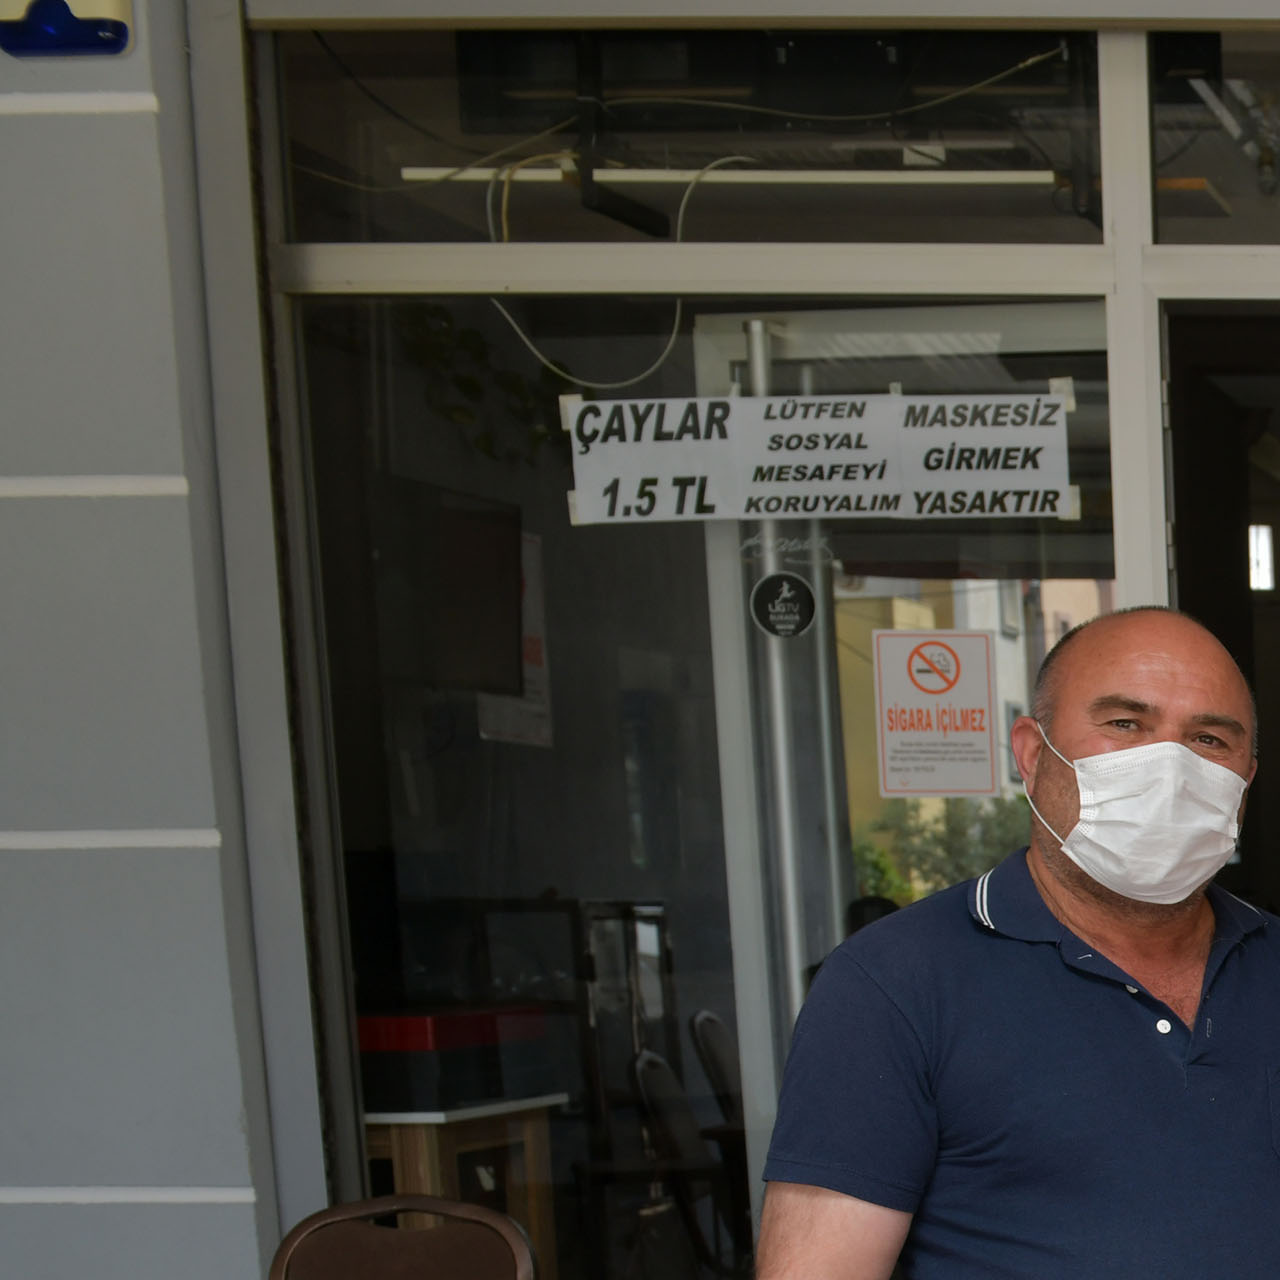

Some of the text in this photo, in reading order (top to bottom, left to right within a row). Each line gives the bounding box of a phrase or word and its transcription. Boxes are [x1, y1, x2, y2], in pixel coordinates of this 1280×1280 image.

[763, 399, 867, 420] LÜTFEN
[903, 398, 1061, 428] MASKESİZ
[575, 400, 730, 454] ÇAYLAR
[768, 433, 868, 451] SOSYAL
[923, 442, 1043, 471] GİRMEK
[752, 459, 887, 482] MESAFEYİ
[602, 476, 717, 517] 1.5 TL
[744, 494, 902, 514] KORUYALIM
[913, 489, 1061, 515] YASAKTIR
[887, 700, 986, 739] SİGARA İÇİLMEZ
